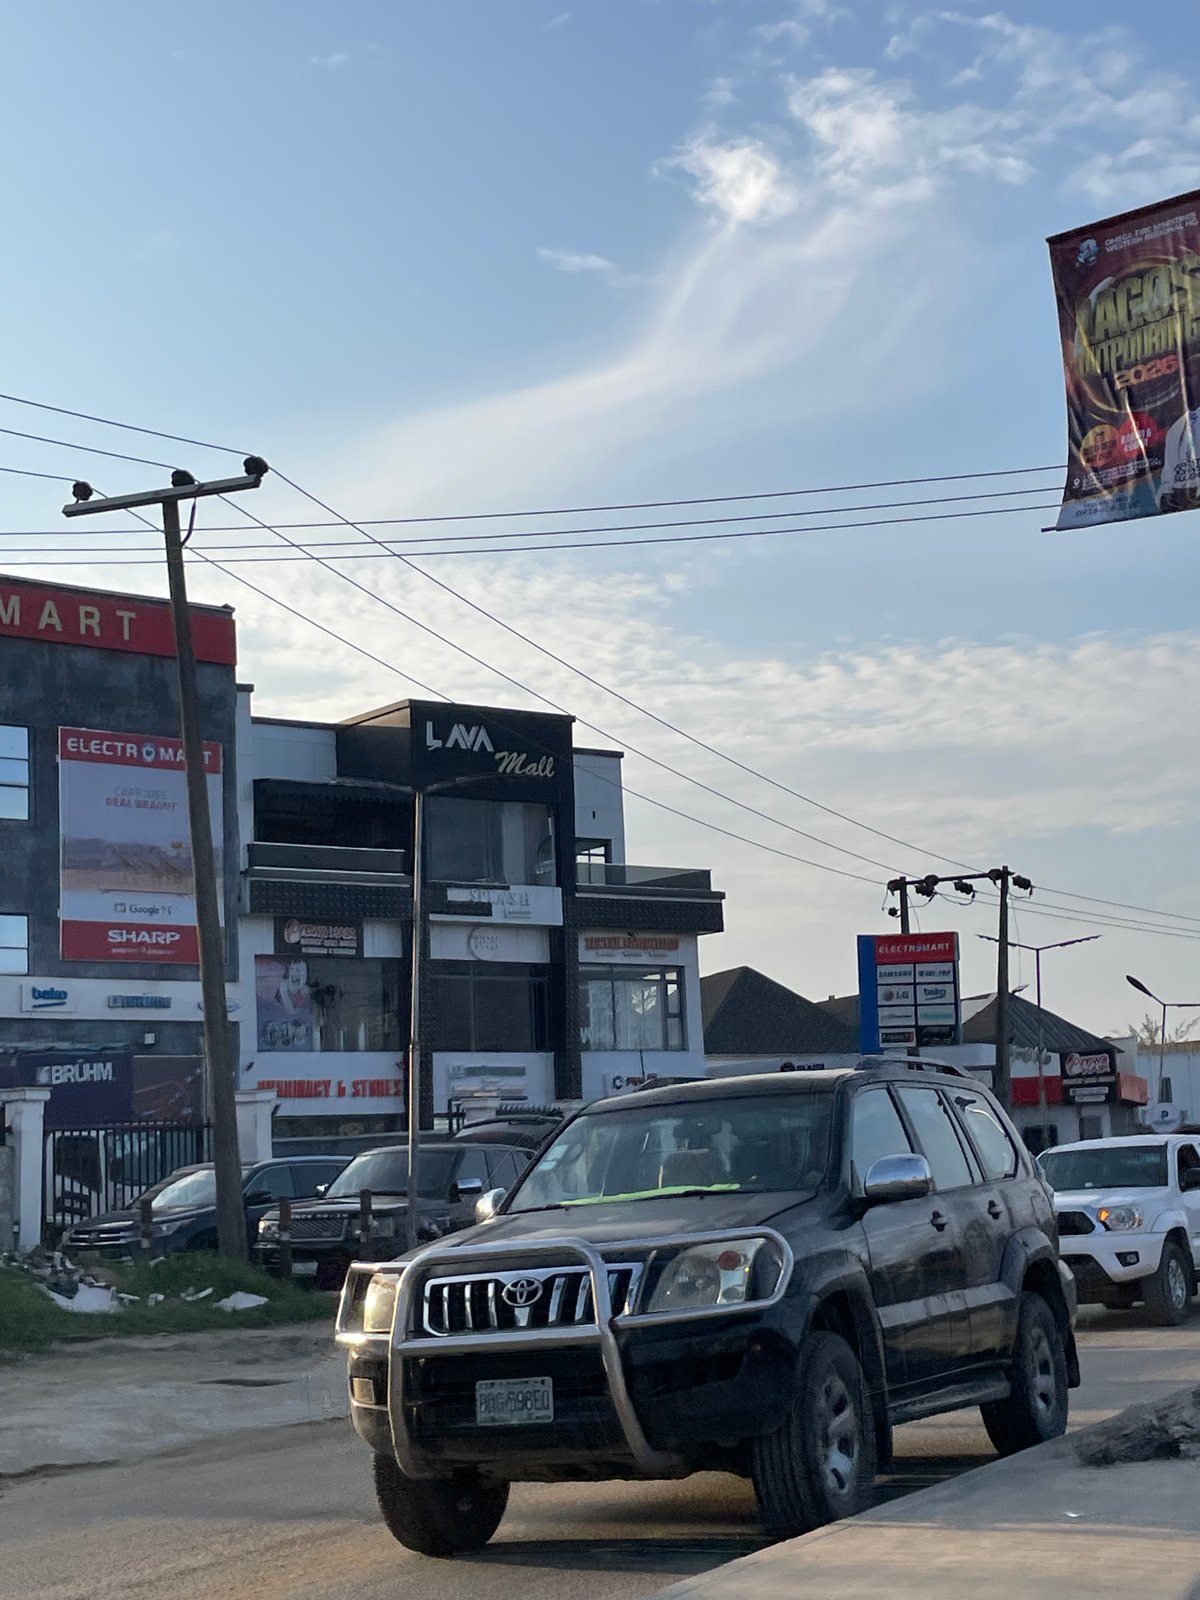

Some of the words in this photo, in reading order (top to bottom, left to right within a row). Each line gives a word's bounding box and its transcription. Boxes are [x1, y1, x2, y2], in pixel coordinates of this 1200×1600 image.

[0, 595, 136, 641] MART
[425, 720, 495, 752] LAVA
[66, 737, 213, 766] ELECTROMAT
[494, 751, 555, 777] Mall
[107, 929, 181, 945] SHARP
[879, 942, 950, 954] ELECTROMART
